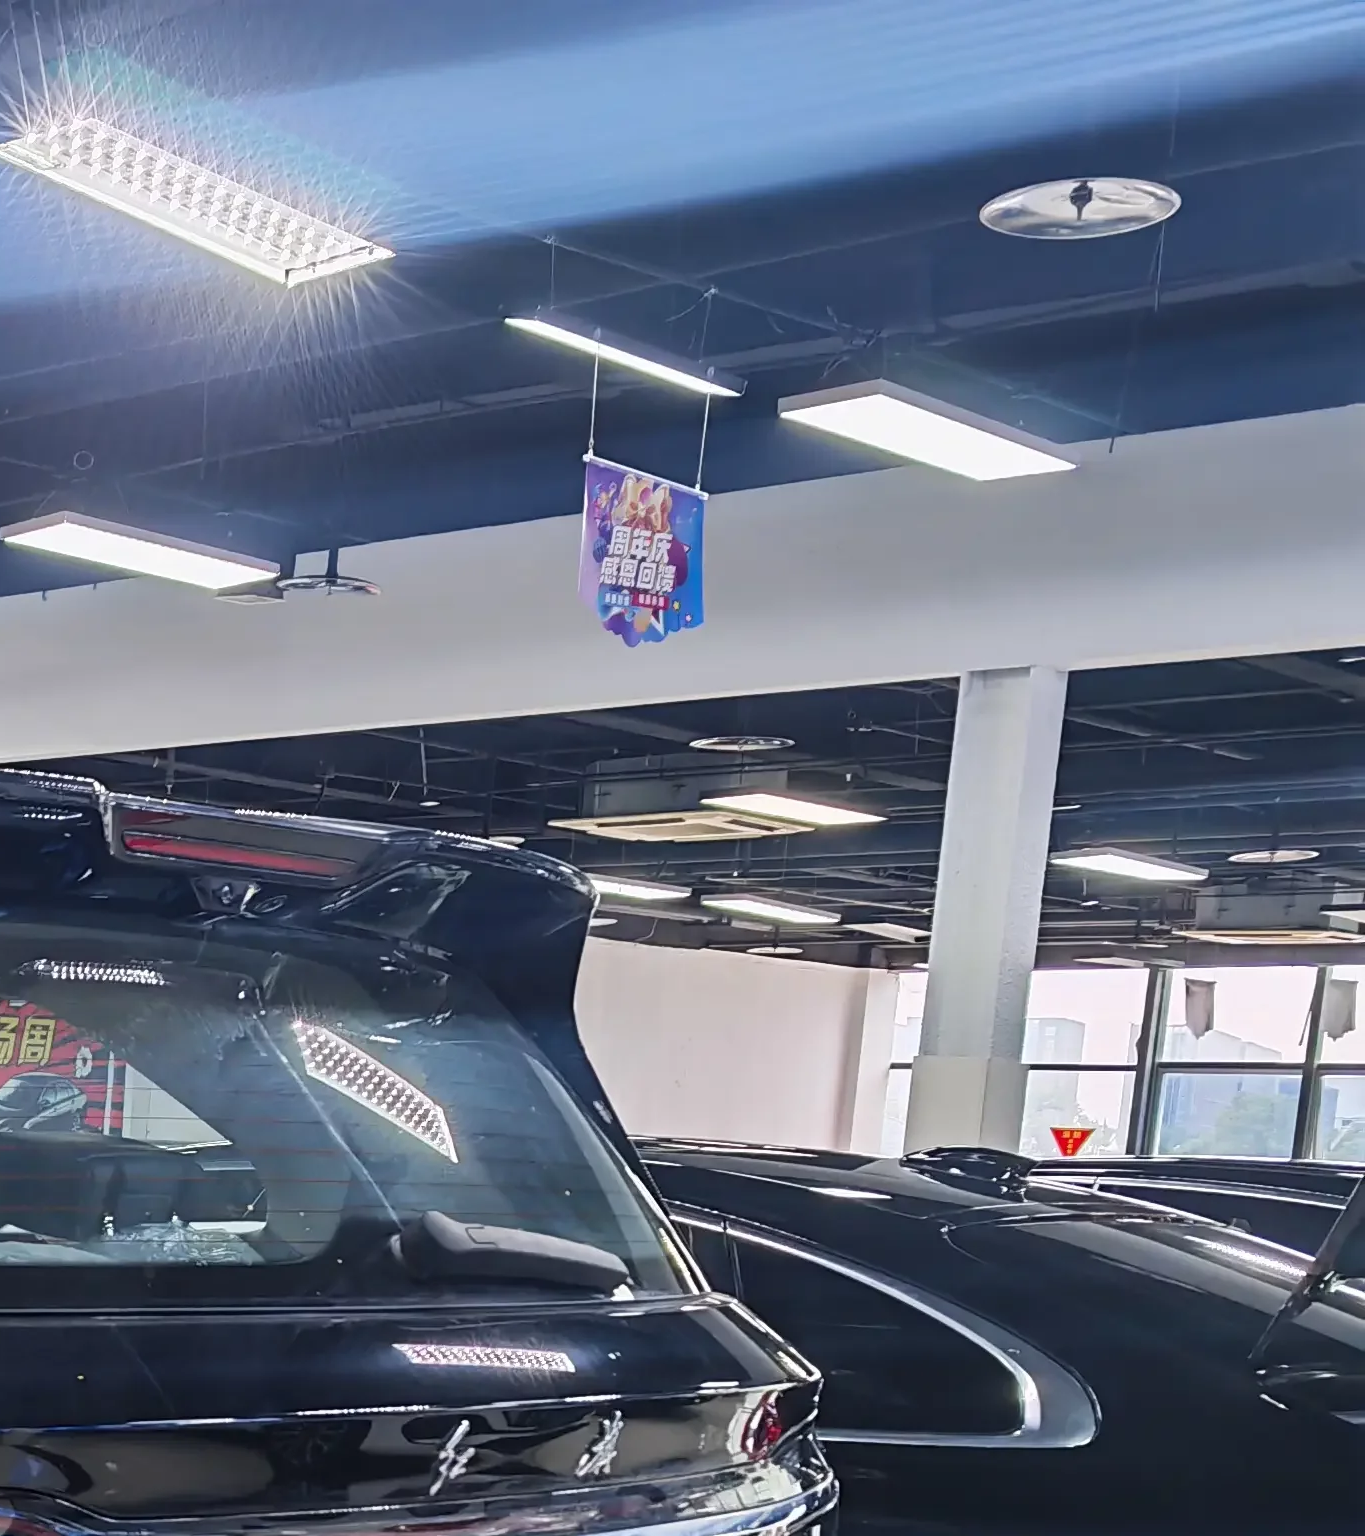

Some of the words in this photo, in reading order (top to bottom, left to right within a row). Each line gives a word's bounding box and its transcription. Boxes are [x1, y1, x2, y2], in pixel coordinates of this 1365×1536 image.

[610, 525, 674, 564] 周年庆
[600, 556, 676, 594] 感恩回馈
